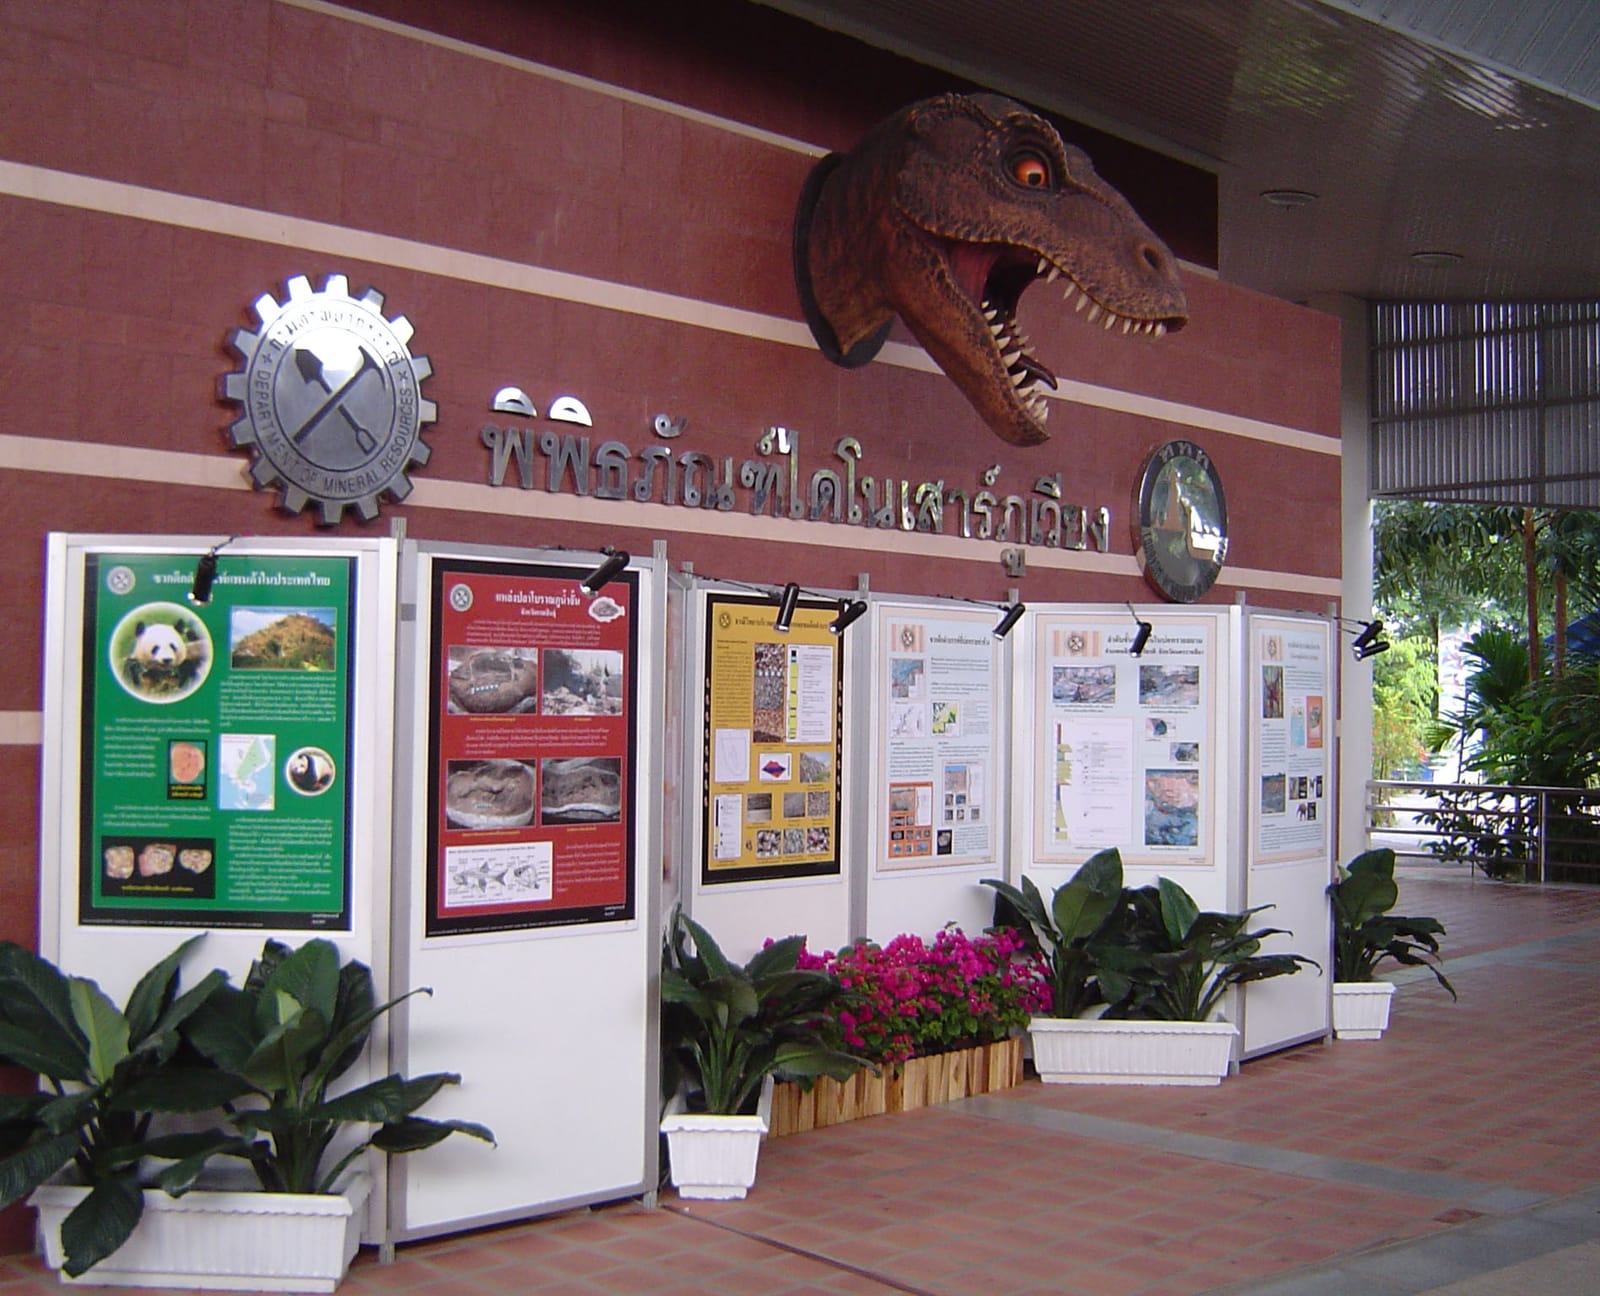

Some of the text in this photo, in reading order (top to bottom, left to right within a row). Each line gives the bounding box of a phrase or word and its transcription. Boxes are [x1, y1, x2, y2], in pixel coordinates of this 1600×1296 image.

[255, 370, 414, 494] DEPARTMENT OF MINERAL RESOURCES
[481, 386, 1112, 577] พิพิธภัณฑ์ไดโนเสาร์ภูเวียง
